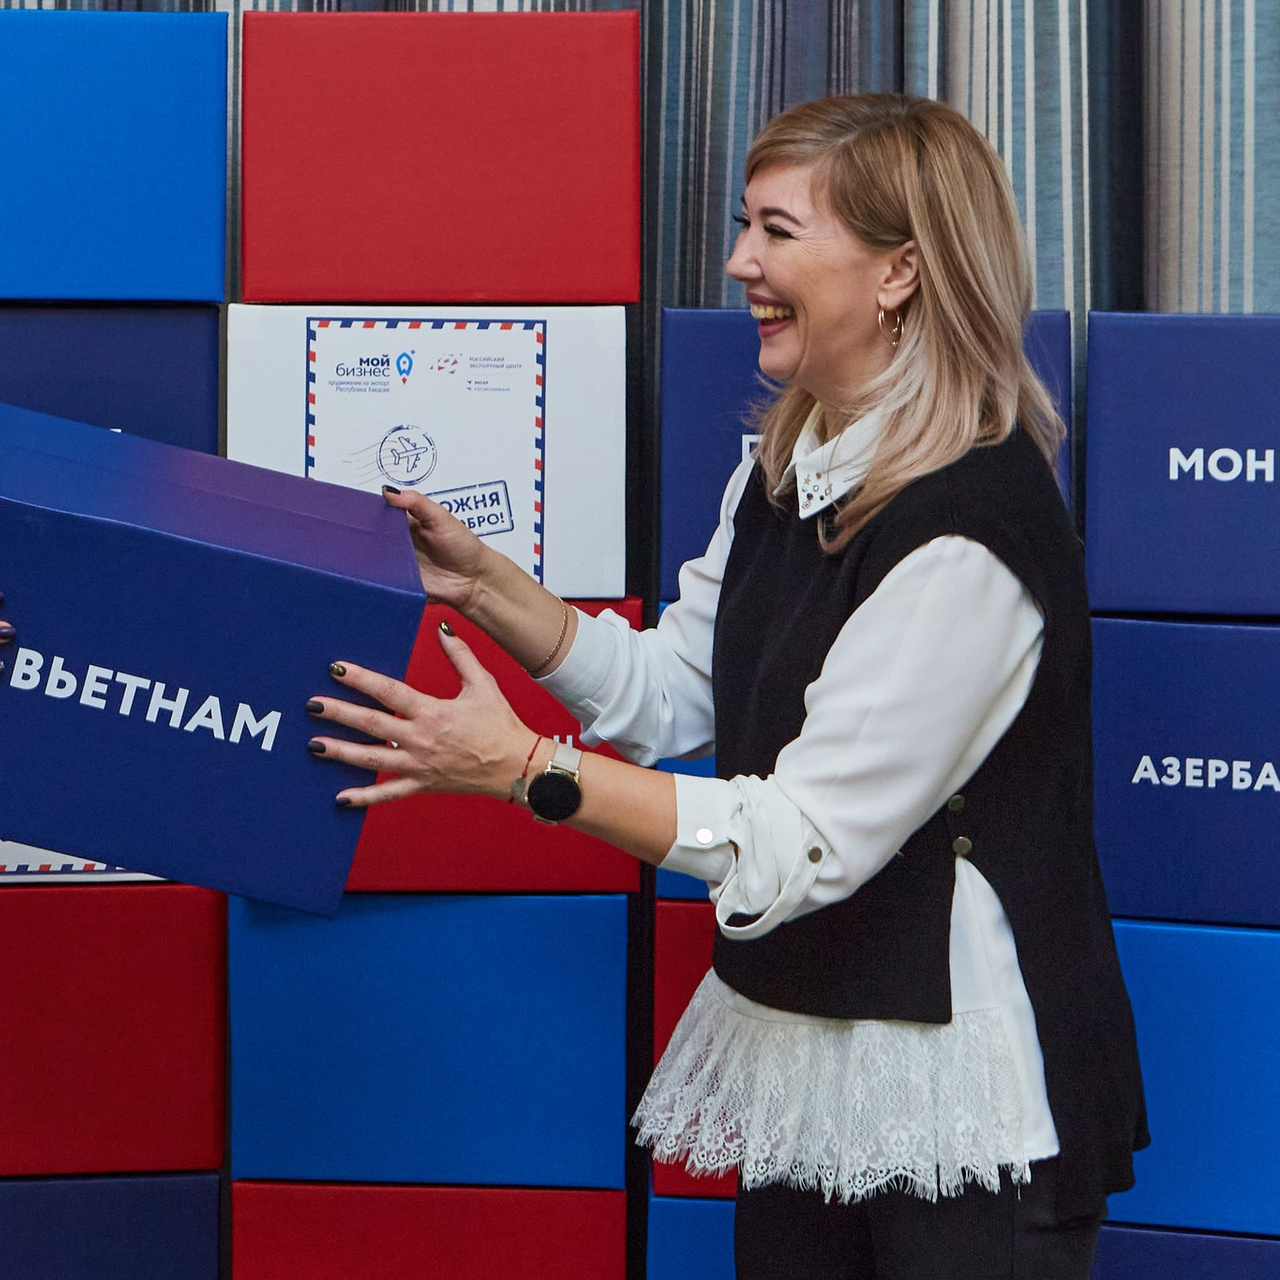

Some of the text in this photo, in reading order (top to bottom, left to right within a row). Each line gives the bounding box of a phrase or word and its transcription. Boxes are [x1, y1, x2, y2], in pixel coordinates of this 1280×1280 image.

[336, 363, 390, 377] бизнес
[359, 354, 390, 367] мой
[1169, 448, 1274, 482] МОН
[439, 491, 501, 514] ОЖНЯ
[461, 512, 505, 529] БРО!
[9, 647, 282, 752] ВЬЕТНАМ
[1131, 755, 1280, 792] АЗЕРБА
